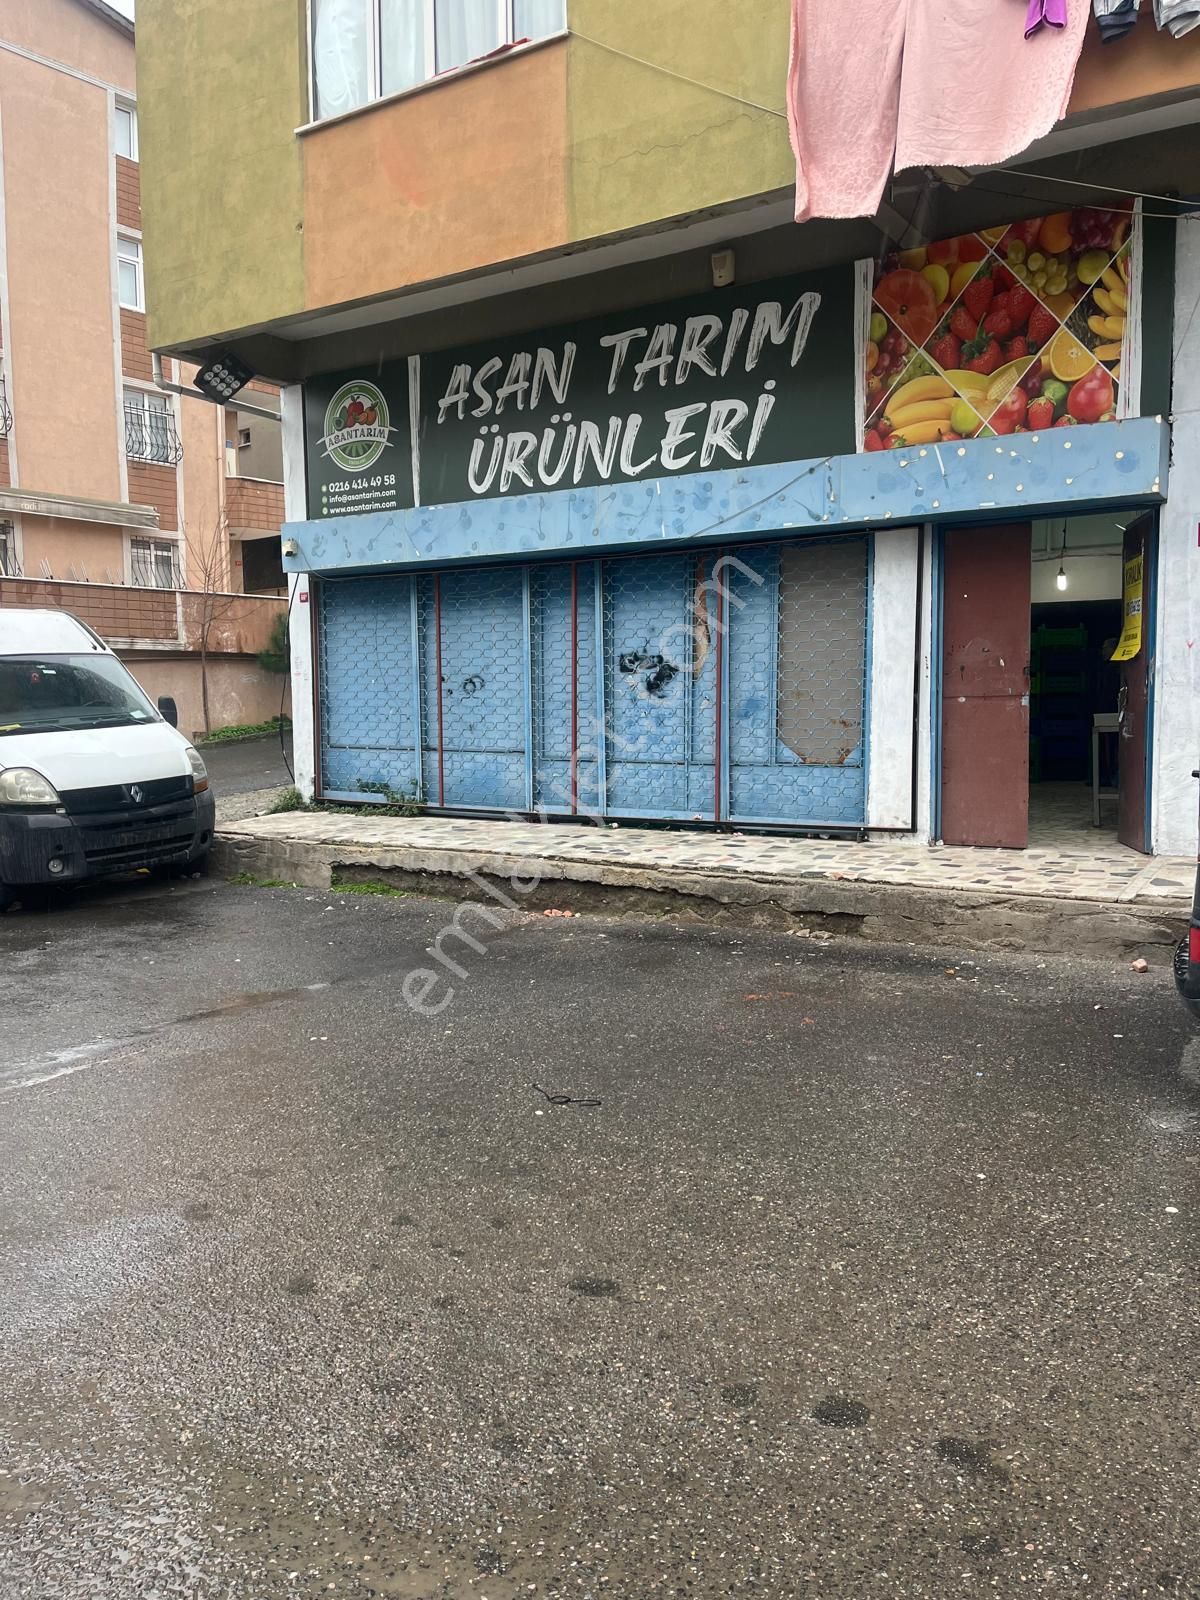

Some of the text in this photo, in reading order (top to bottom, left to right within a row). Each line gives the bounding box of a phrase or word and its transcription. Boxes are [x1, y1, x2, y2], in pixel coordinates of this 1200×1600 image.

[438, 291, 821, 424] ASAN TARIM
[467, 379, 776, 494] ÜRÜNLERİ
[328, 474, 395, 493] 0216 414 49 58
[329, 489, 396, 503] info@asantarim.com
[330, 501, 397, 514] www.asantarim.com
